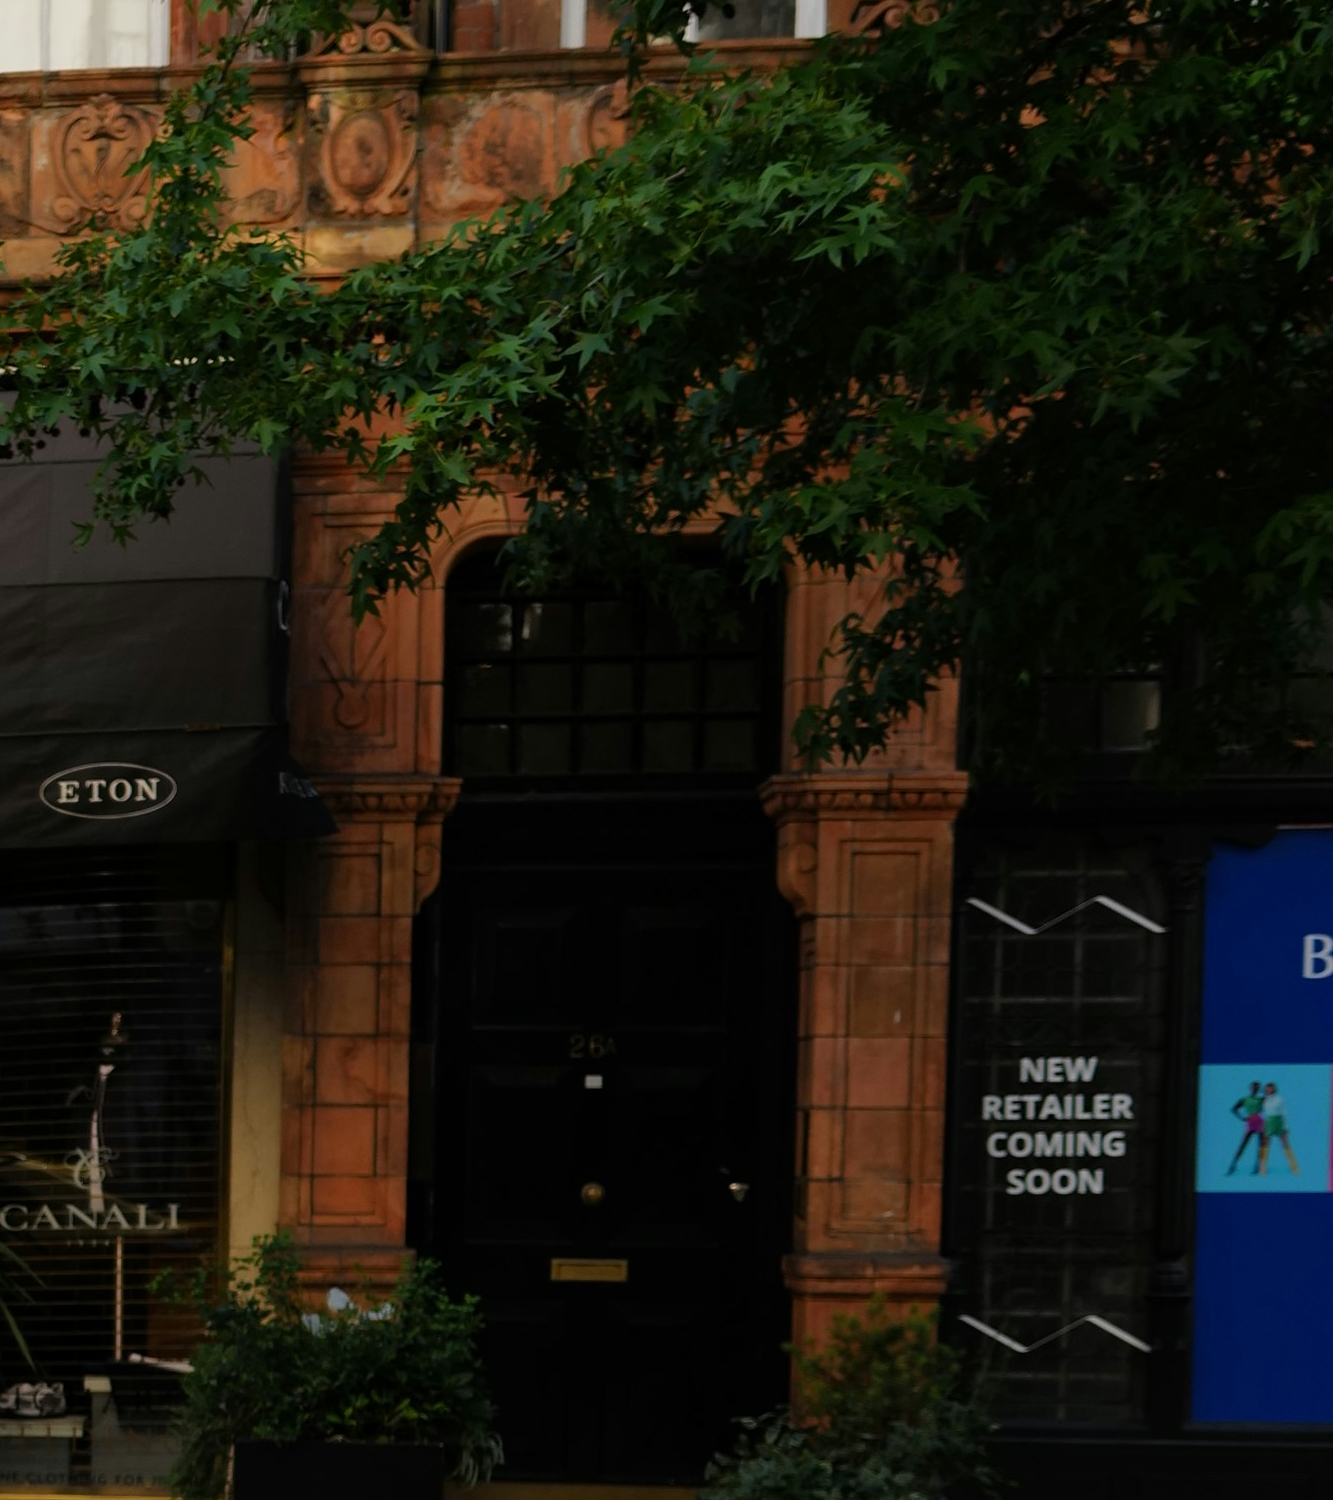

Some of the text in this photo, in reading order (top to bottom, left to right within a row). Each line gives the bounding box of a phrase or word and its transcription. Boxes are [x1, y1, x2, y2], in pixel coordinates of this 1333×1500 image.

[56, 777, 160, 804] ETON
[1302, 932, 1333, 980] B
[1018, 1056, 1099, 1083] NEW
[981, 1093, 1135, 1121] RETAILER
[986, 1130, 1127, 1159] COMING
[1005, 1167, 1105, 1195] SOON
